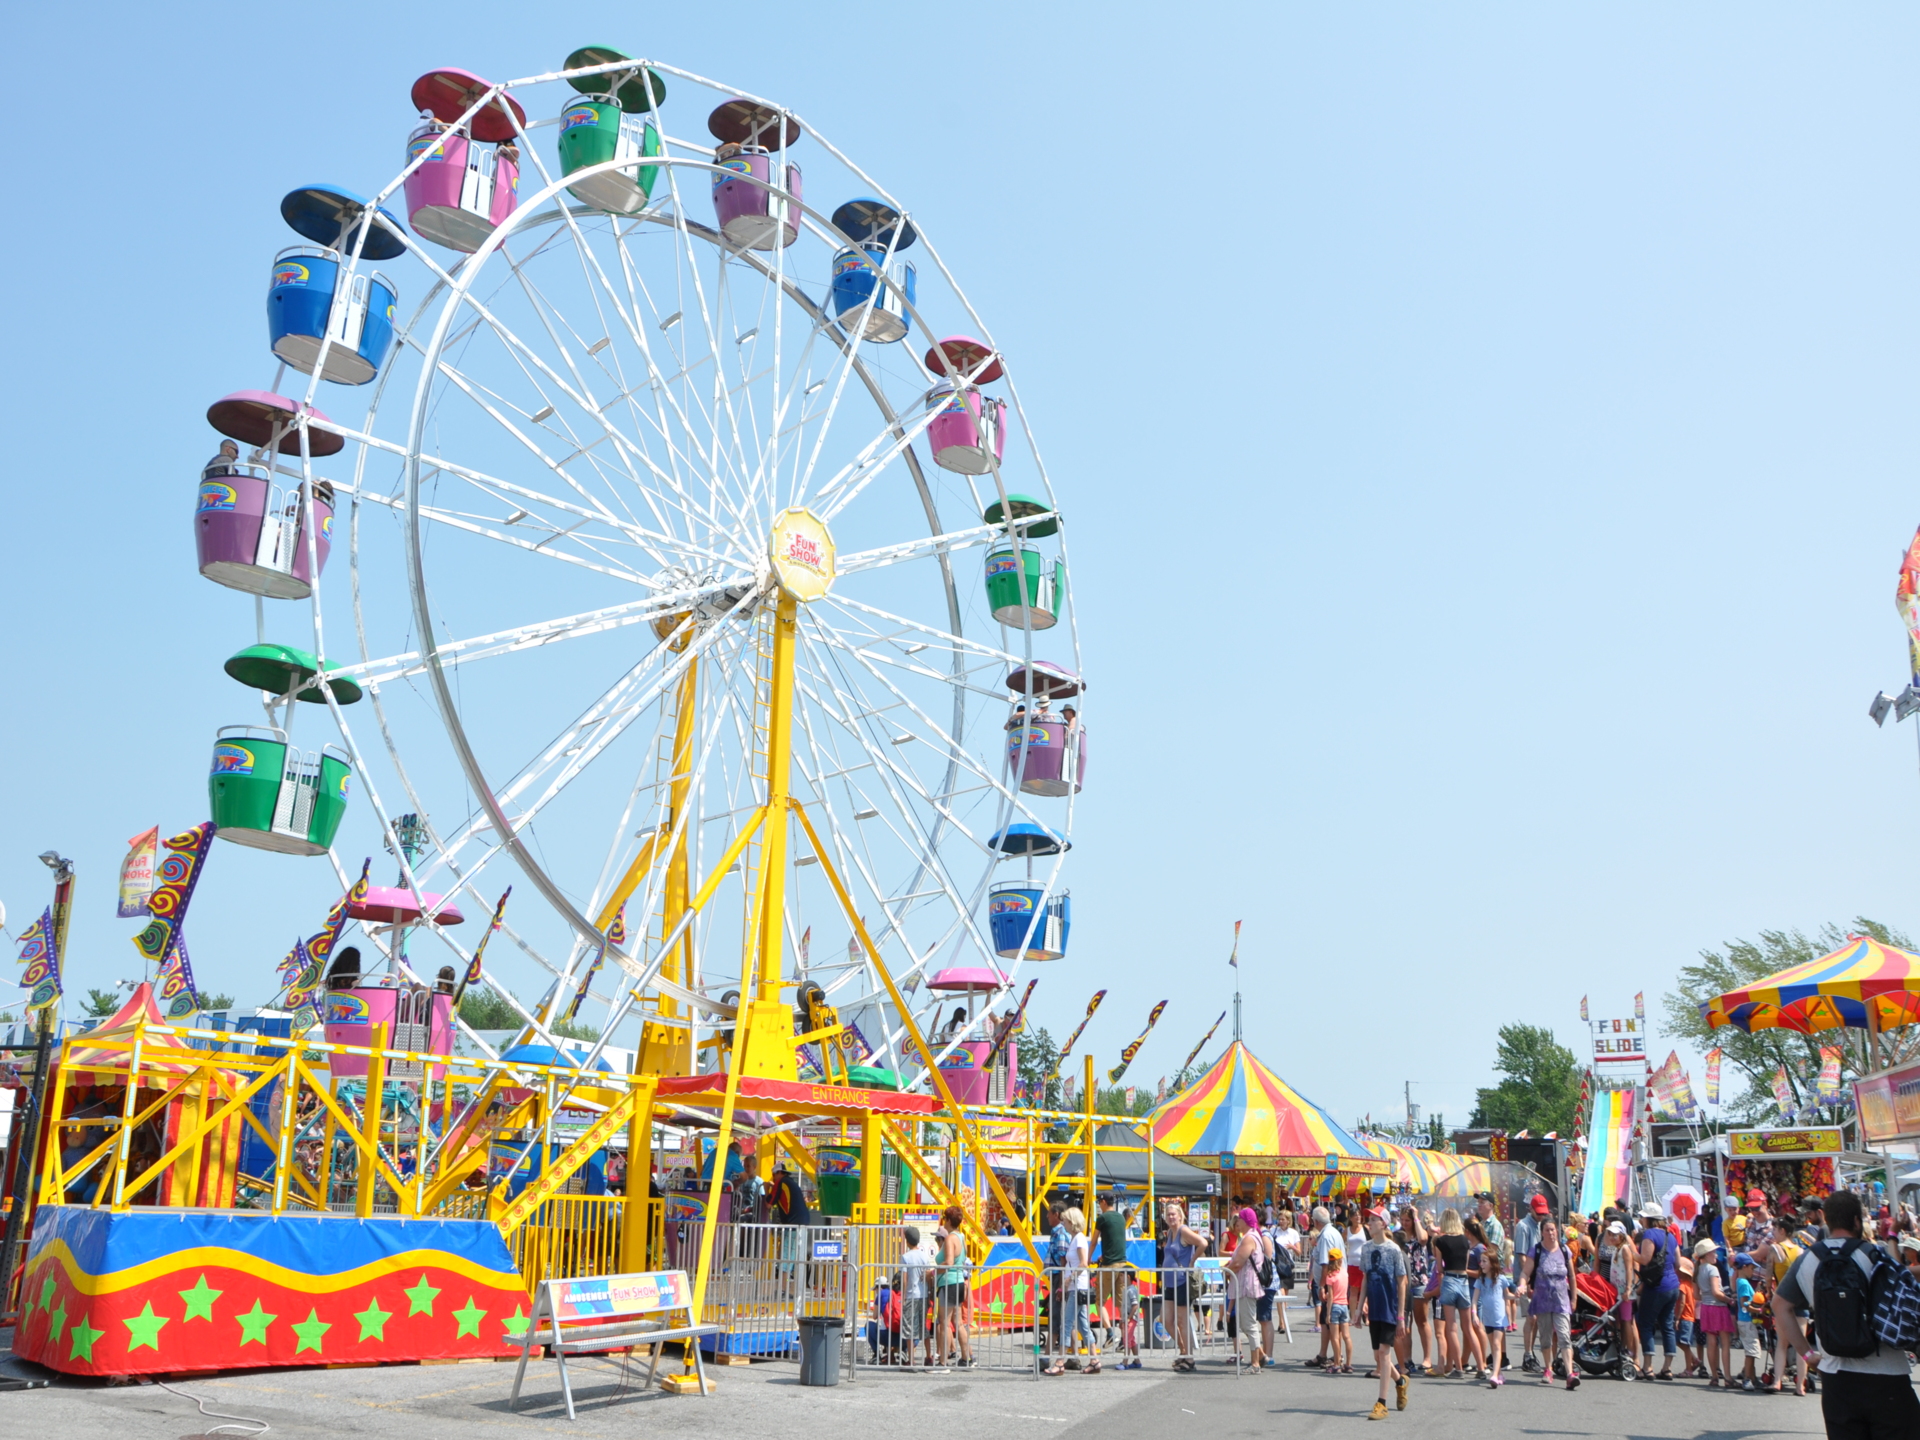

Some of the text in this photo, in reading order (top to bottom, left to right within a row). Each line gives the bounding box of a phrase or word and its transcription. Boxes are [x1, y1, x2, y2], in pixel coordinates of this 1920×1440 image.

[795, 534, 817, 552] FUN
[789, 544, 821, 566] SHOW
[1595, 1037, 1643, 1054] SLIDE
[812, 1086, 871, 1105] ENTRANCE
[1767, 1136, 1797, 1147] CANARD
[816, 1244, 839, 1255] ENTRÉE
[563, 1291, 612, 1304] AMUSEMENT
[612, 1288, 631, 1301] FUN
[633, 1286, 657, 1298] SHOW
